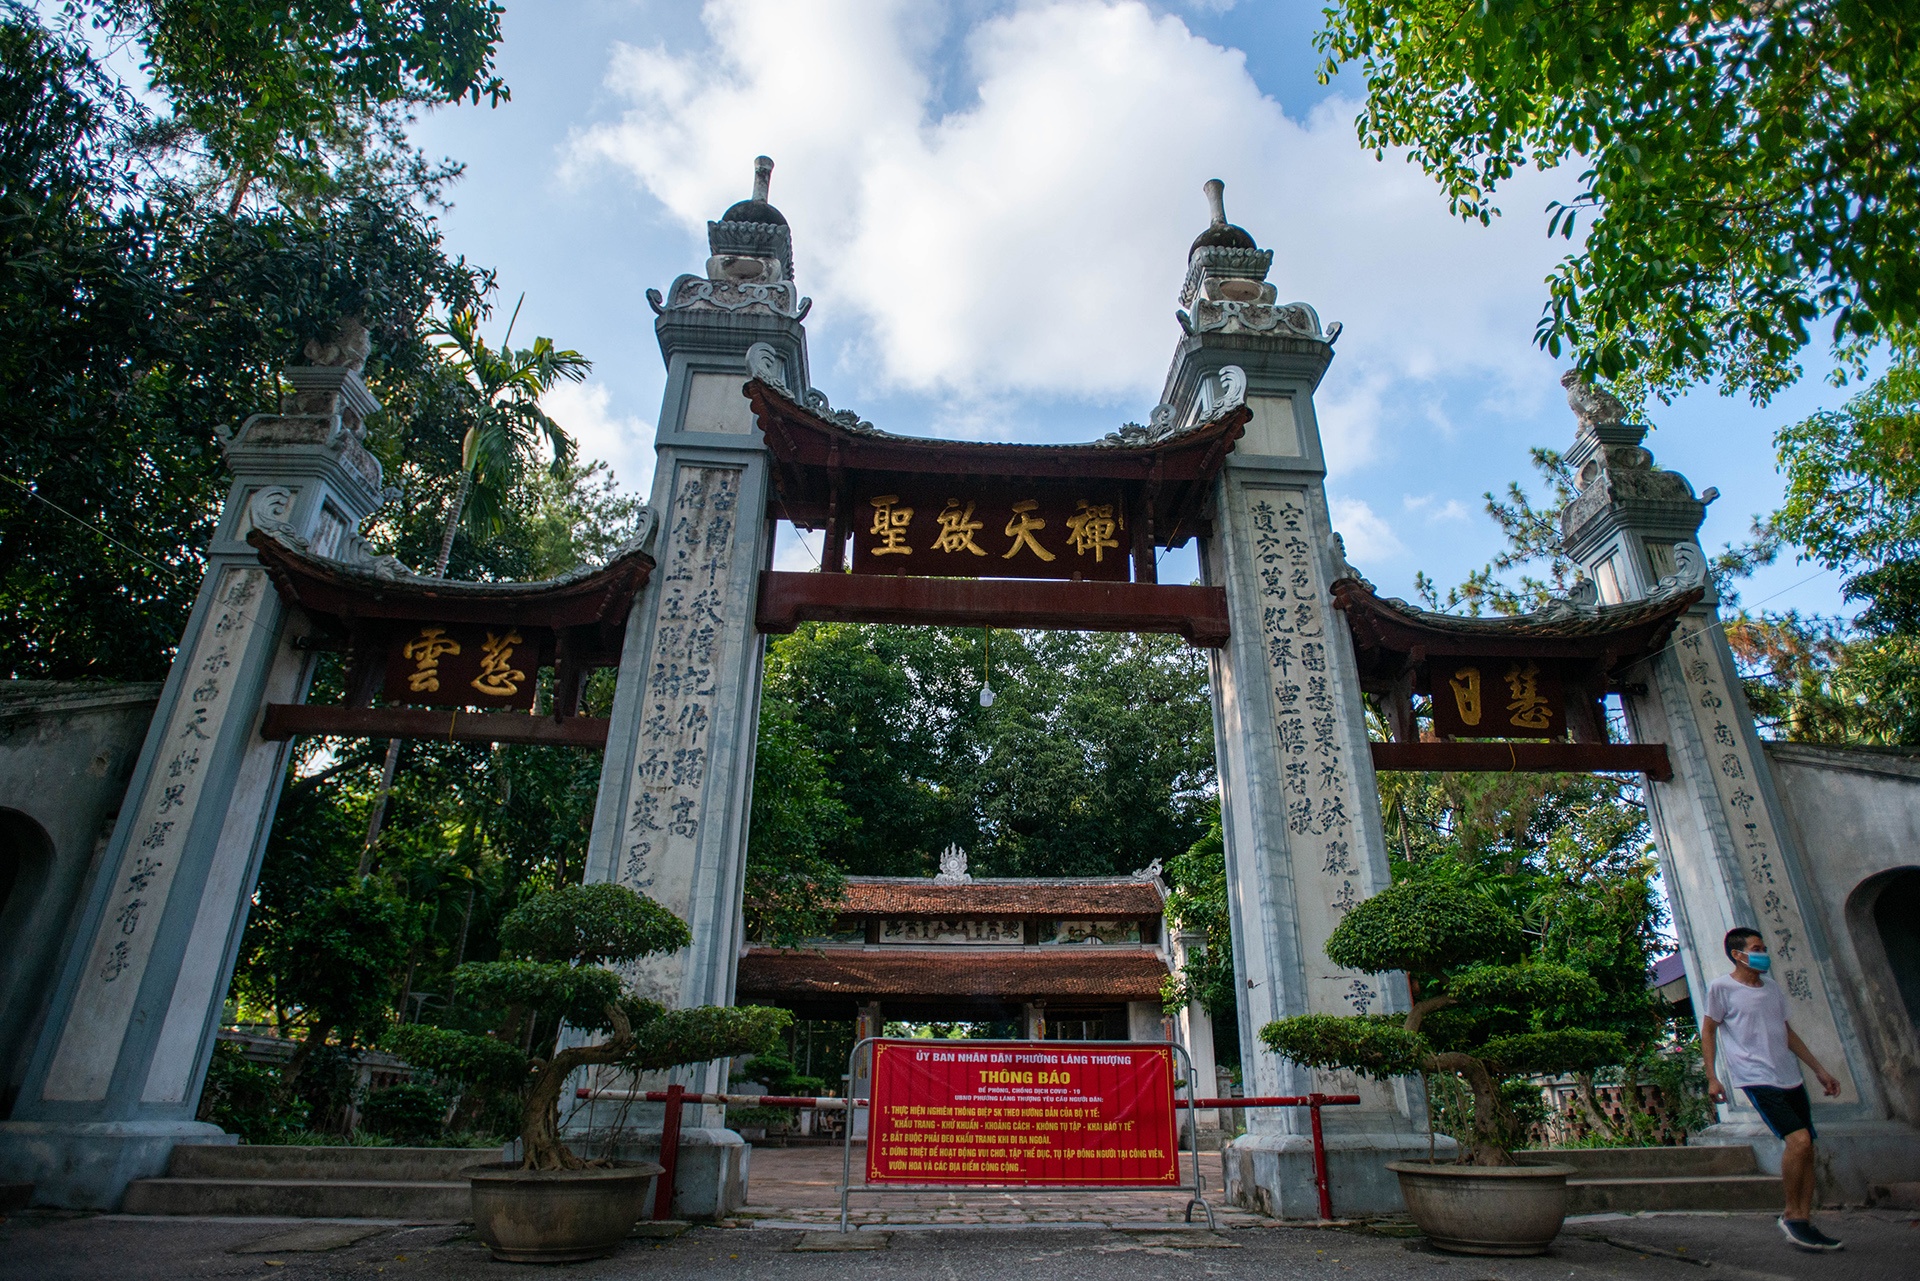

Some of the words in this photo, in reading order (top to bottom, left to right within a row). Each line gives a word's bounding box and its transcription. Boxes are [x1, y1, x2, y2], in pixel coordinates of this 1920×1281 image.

[916, 1050, 929, 1061] ỦY
[933, 1054, 955, 1062] BAN
[958, 1053, 987, 1062] NHÂN
[991, 1054, 1012, 1063] DÂN
[1016, 1053, 1058, 1064] PHƯỜNG
[1061, 1054, 1088, 1064] LÁNG
[1091, 1056, 1131, 1066] THƯỢNG
[979, 1069, 1033, 1084] THÔNG
[1038, 1070, 1070, 1084] BÁO
[994, 1108, 1002, 1116] 5K
[1004, 1108, 1020, 1116] THEO
[1085, 1109, 1088, 1117] Y
[914, 1120, 935, 1128] TRANG
[1118, 1123, 1123, 1131] Y
[975, 1135, 996, 1144] TRANG
[998, 1135, 1008, 1144] KHI
[1019, 1136, 1027, 1144] RA
[909, 1162, 922, 1170] HOA
